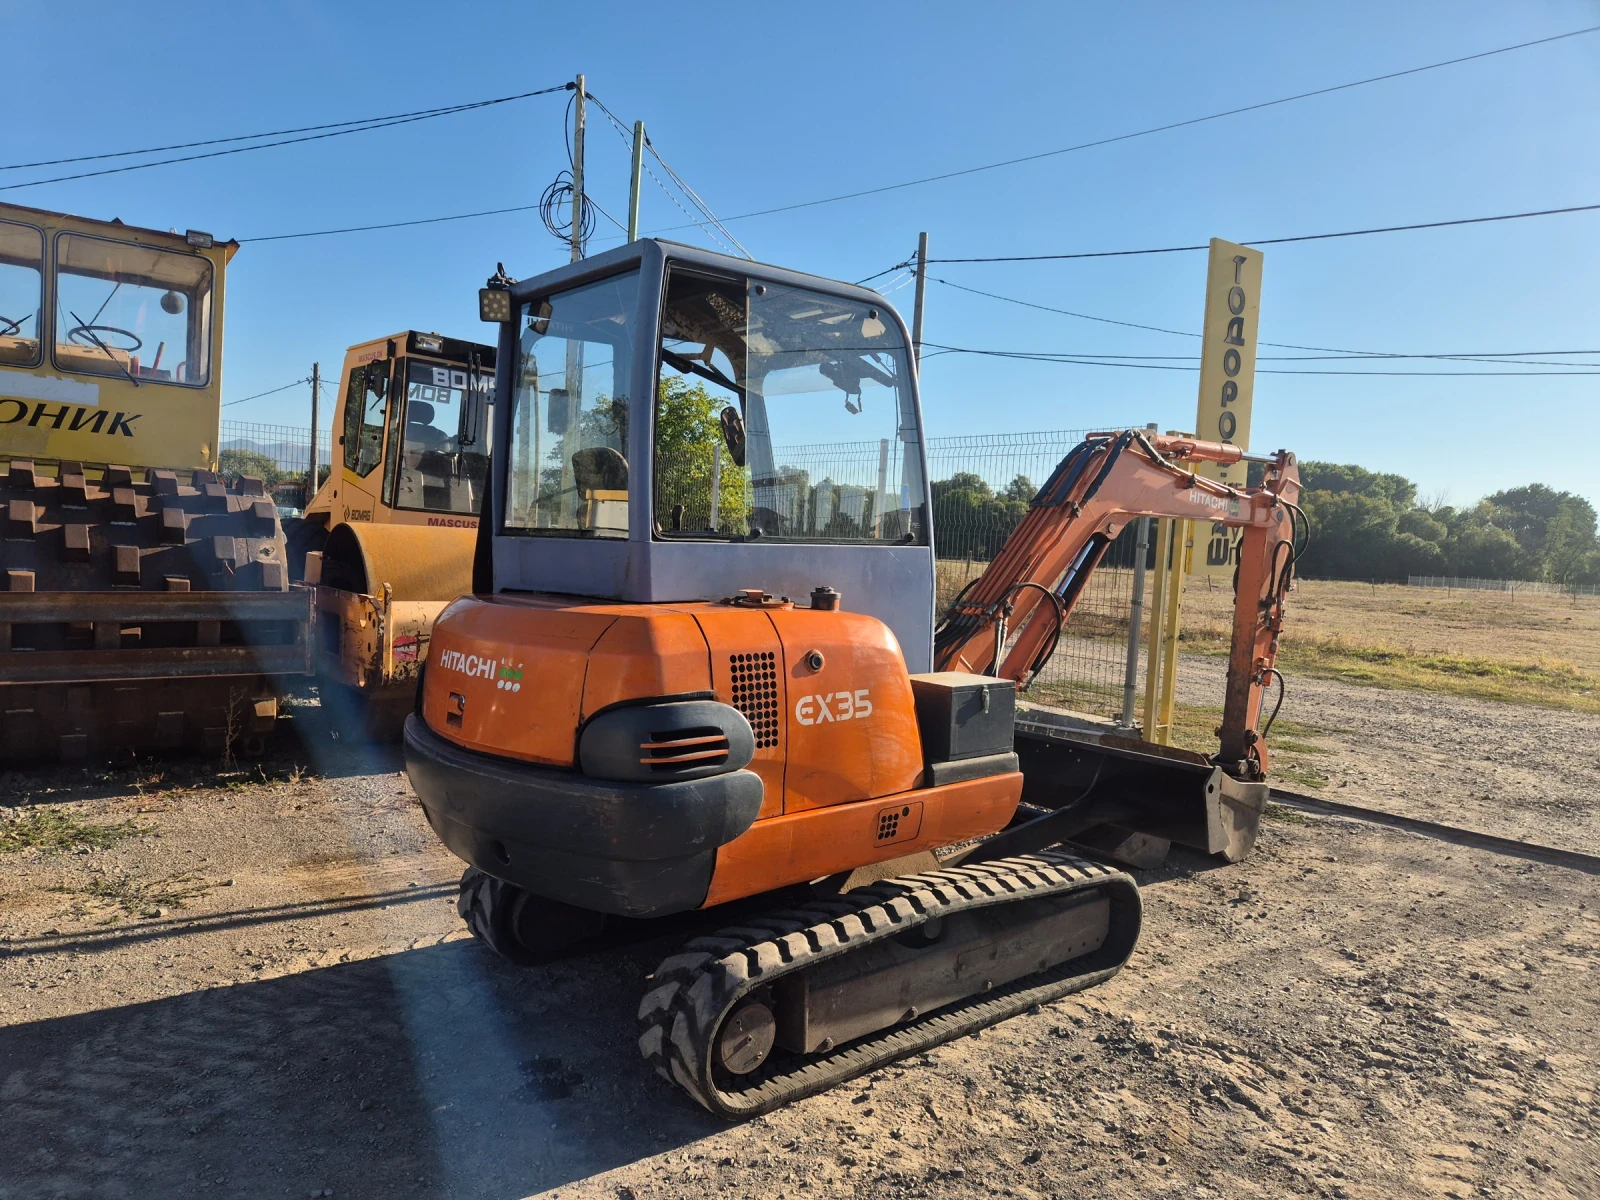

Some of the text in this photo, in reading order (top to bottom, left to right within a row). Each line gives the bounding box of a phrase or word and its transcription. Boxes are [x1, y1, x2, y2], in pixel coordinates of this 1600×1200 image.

[1189, 490, 1228, 511] HITACHI
[350, 509, 371, 521] BOMAG
[427, 517, 478, 529] MASCUS
[440, 649, 497, 680] HITACHI
[795, 688, 873, 726] EX35
